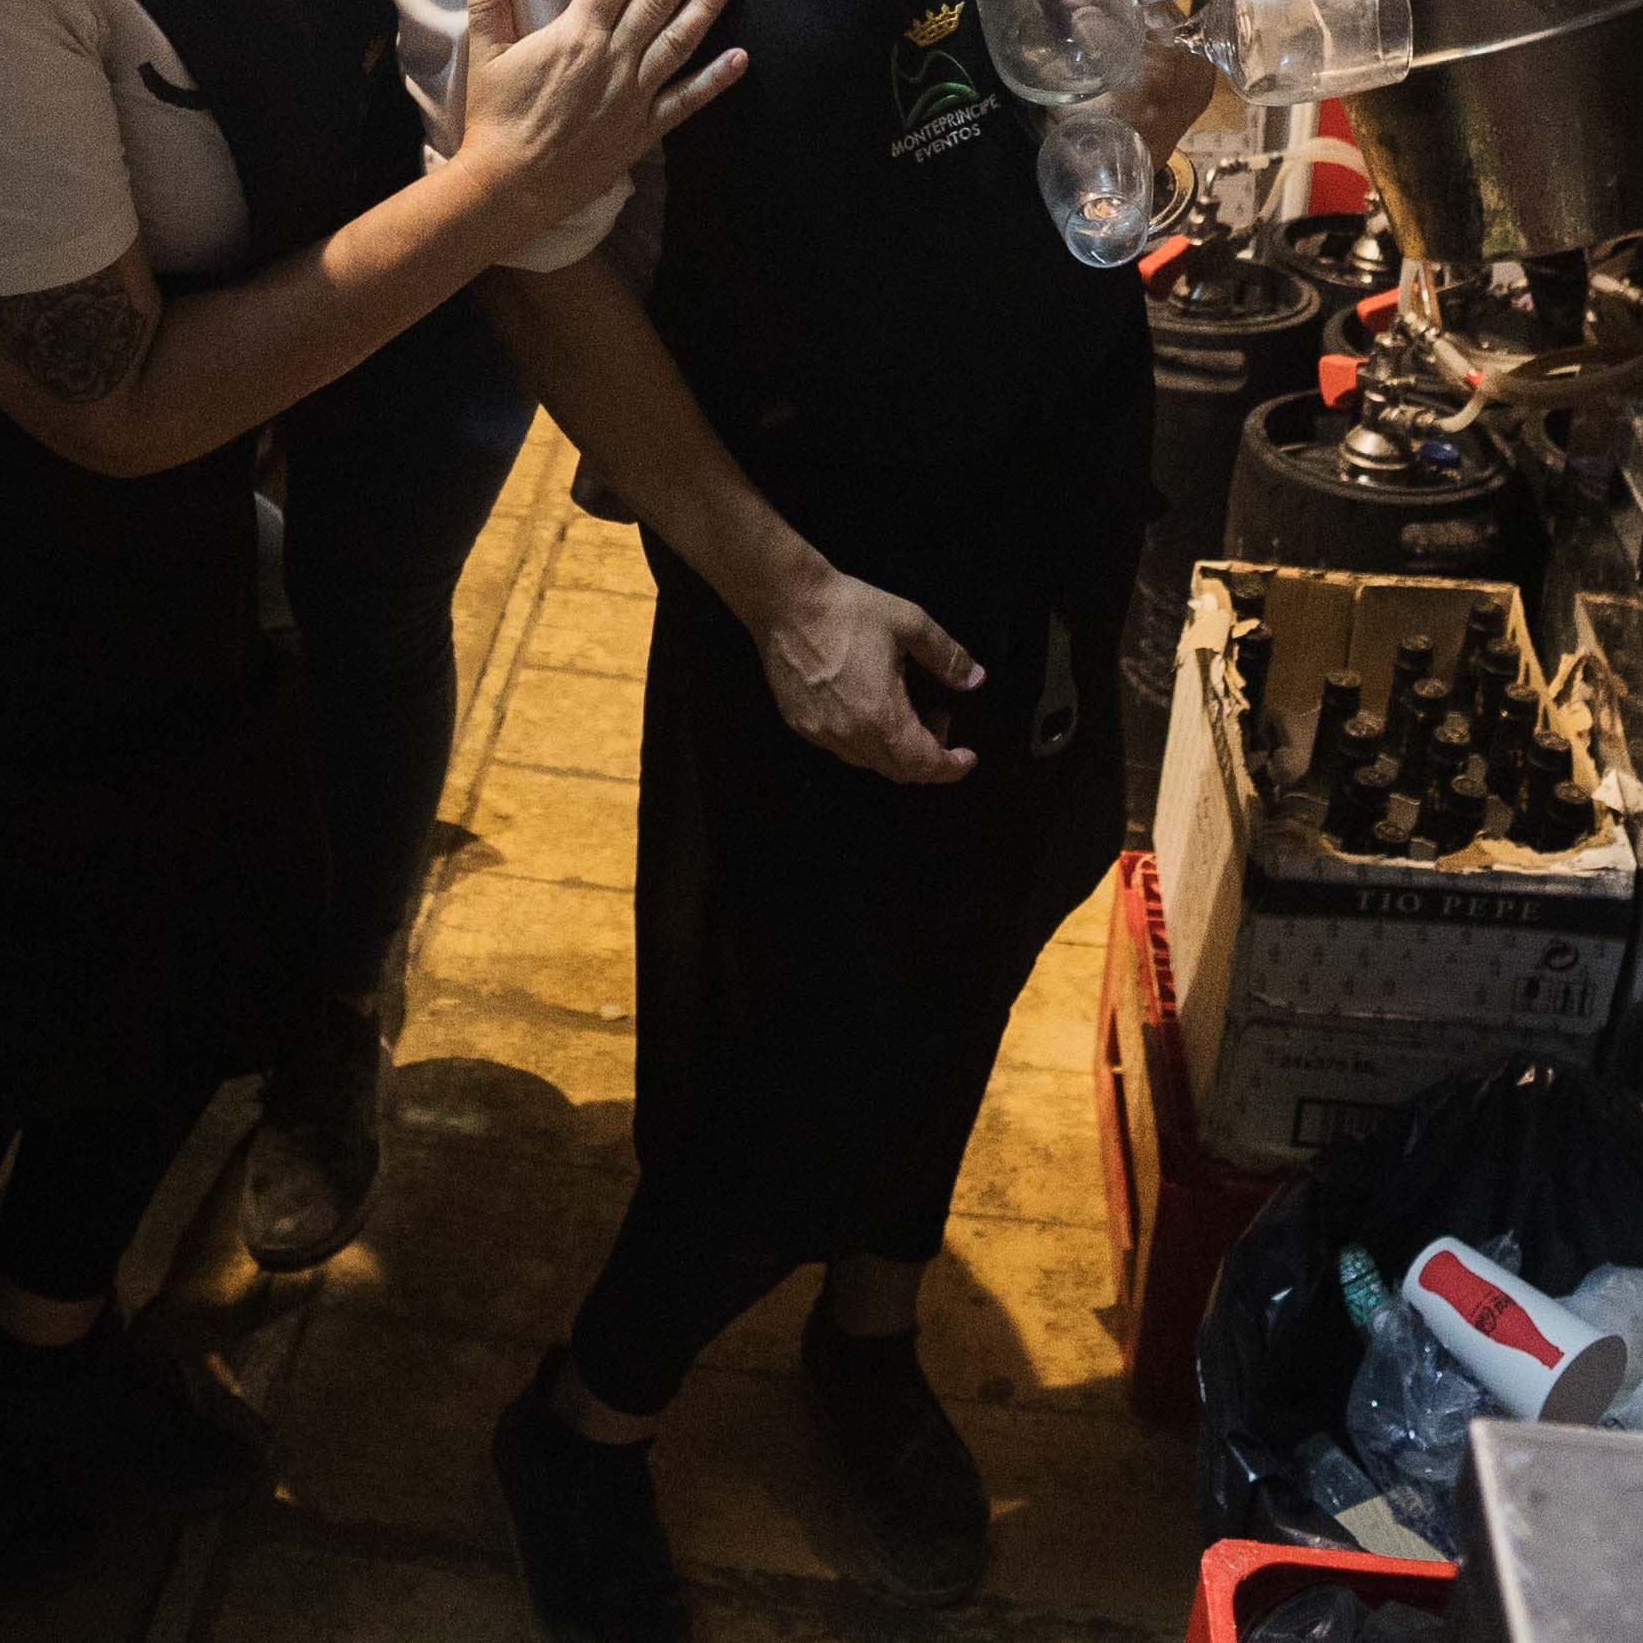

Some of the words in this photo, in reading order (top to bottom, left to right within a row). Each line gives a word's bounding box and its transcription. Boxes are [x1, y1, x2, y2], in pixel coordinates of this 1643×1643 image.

[914, 122, 982, 163] EVENTOS
[1355, 890, 1423, 915] TIO
[1442, 894, 1543, 924] PEPE
